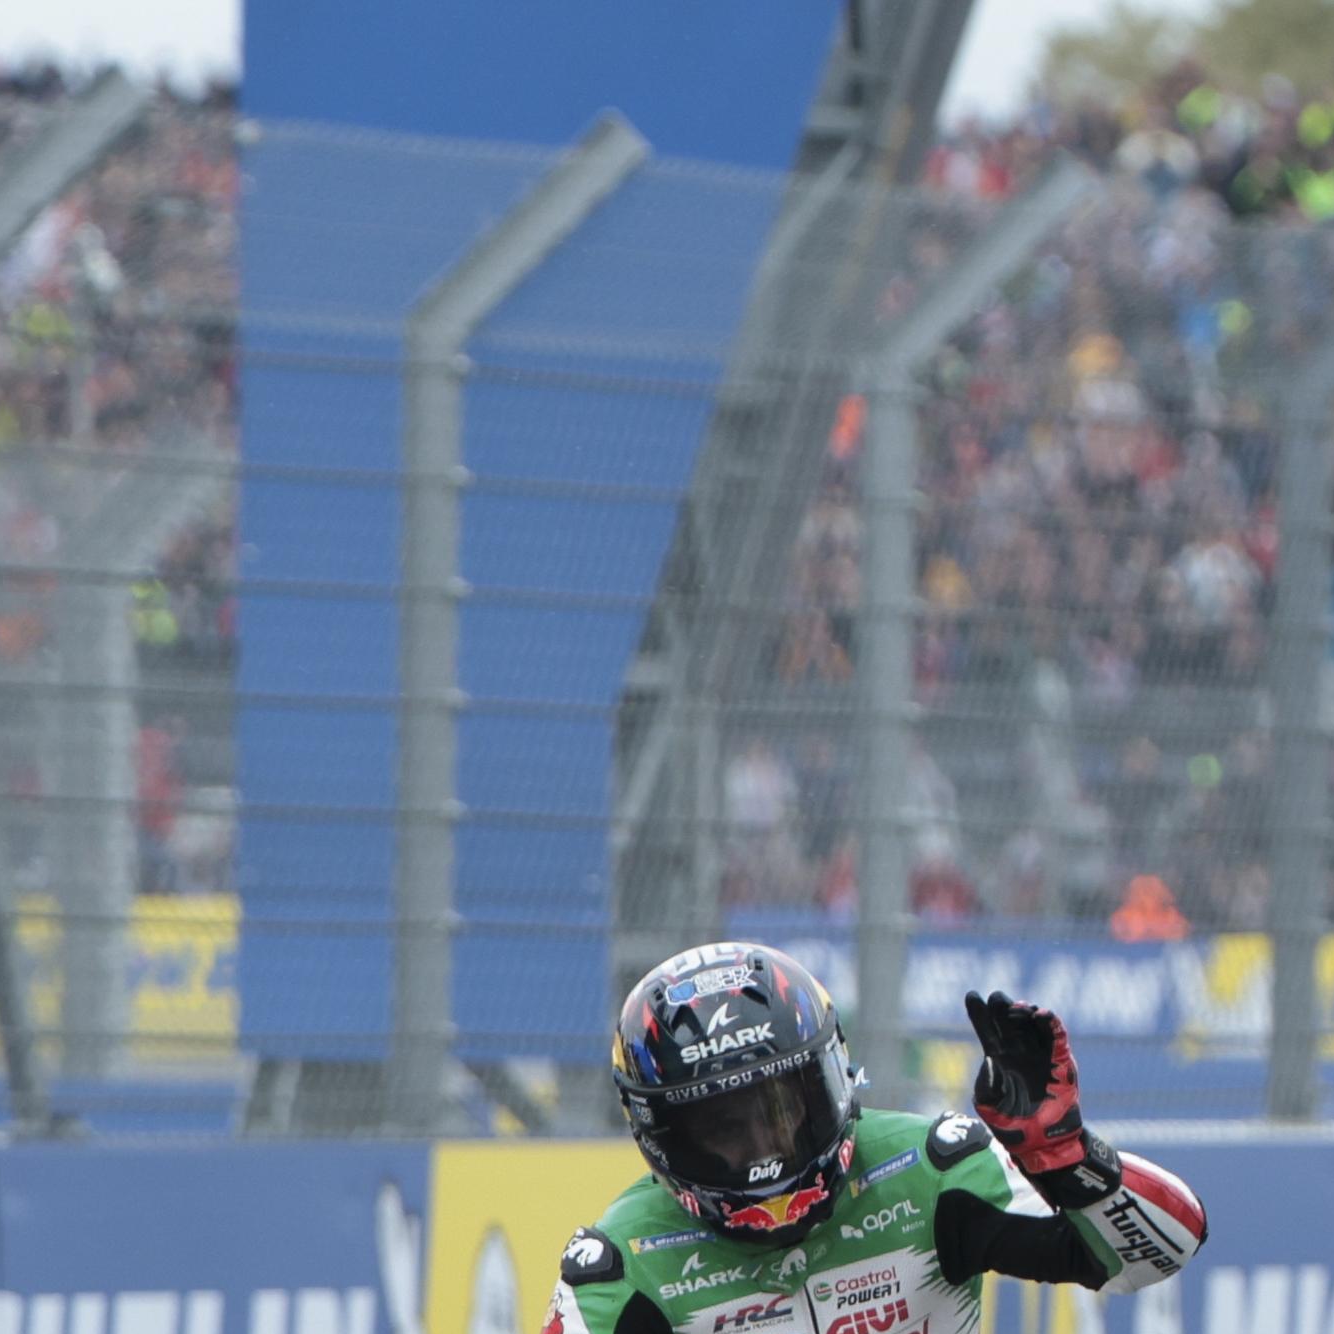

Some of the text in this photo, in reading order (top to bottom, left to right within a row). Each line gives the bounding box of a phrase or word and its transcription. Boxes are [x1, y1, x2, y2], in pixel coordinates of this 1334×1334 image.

[680, 1022, 775, 1065] SHARK
[665, 1050, 812, 1103] GIVES YOU WINGS
[748, 1160, 783, 1183] Dafy
[868, 1153, 914, 1183] MICHELIN
[862, 1199, 921, 1233] april
[655, 1231, 708, 1246] MICHELIN
[659, 1267, 745, 1300] SHARK
[835, 1266, 898, 1294] Castrol
[713, 1293, 795, 1333] HRC
